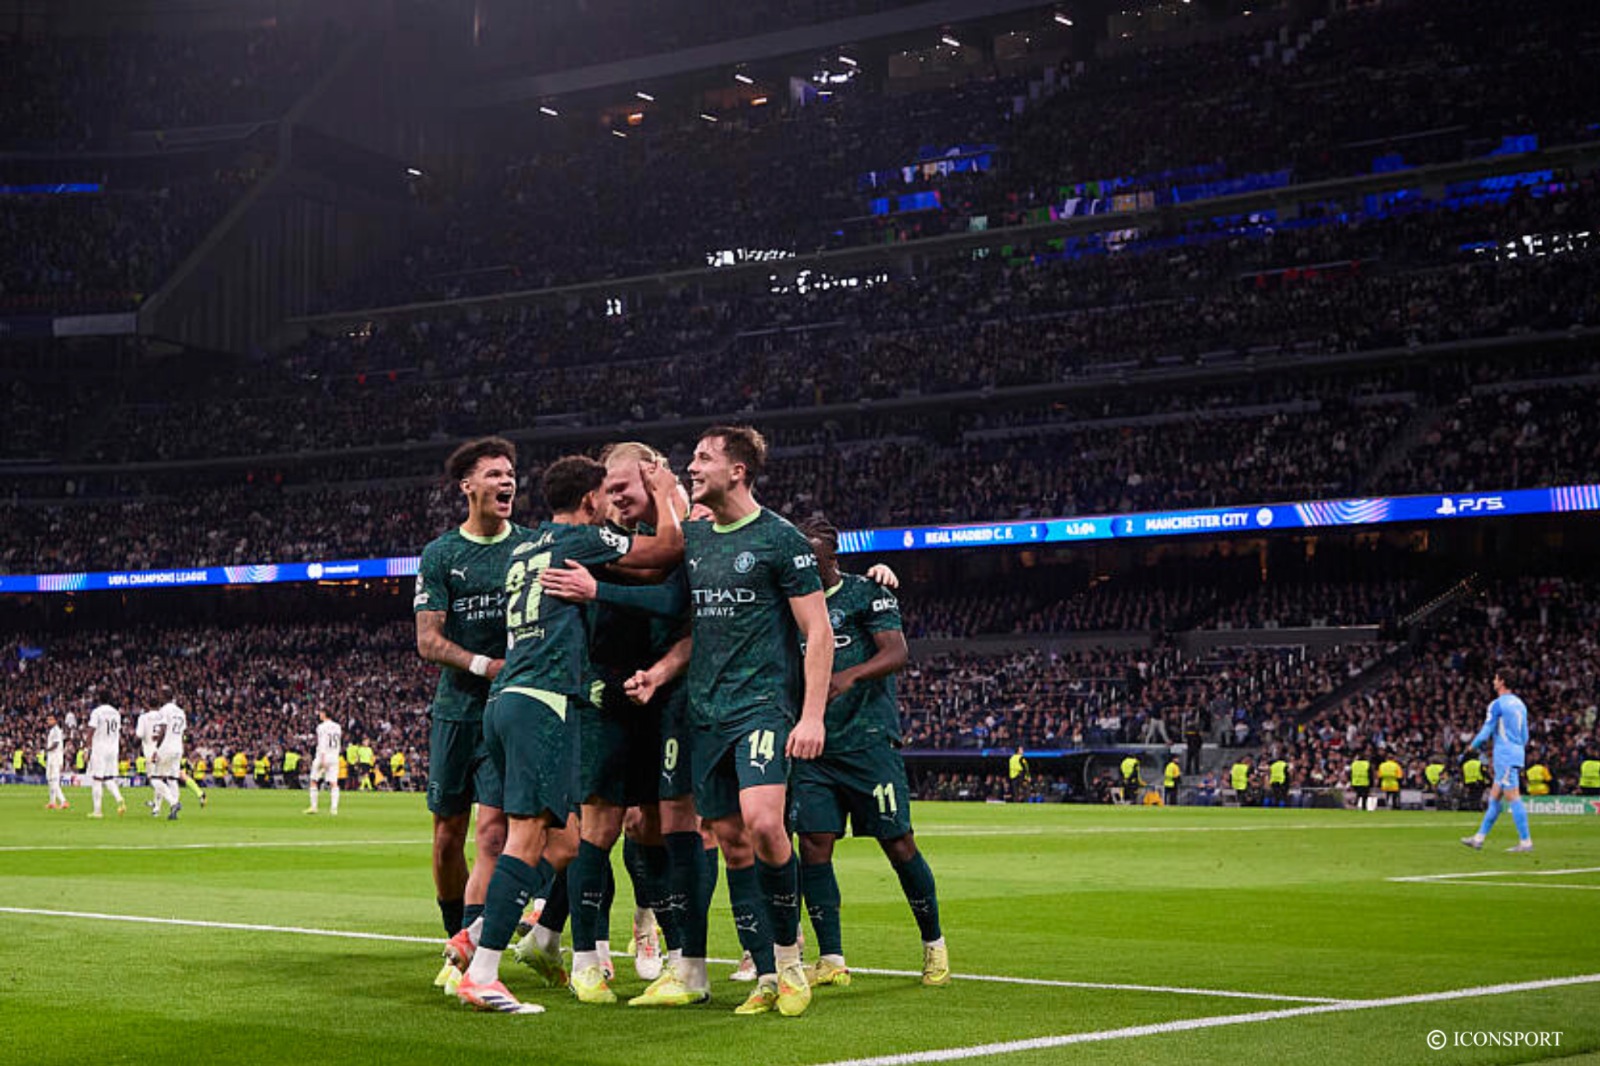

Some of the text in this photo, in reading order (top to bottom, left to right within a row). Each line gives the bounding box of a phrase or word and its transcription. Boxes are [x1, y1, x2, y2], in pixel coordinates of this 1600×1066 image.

[1458, 496, 1505, 512] PS5
[924, 531, 951, 544] REAL
[952, 529, 993, 542] MADRID
[1030, 525, 1037, 539] 1
[1125, 519, 1133, 533] 2
[1145, 514, 1220, 531] MANCHESTER
[1222, 512, 1249, 527] CITY
[504, 551, 552, 628] 27
[691, 587, 756, 603] TIHAD
[467, 609, 504, 620] AIRWA
[696, 606, 735, 617] AIRWAYS
[105, 719, 118, 736] 10
[327, 732, 340, 749] 15
[748, 729, 775, 761] 14
[664, 737, 679, 770] 9
[873, 782, 897, 813] 11
